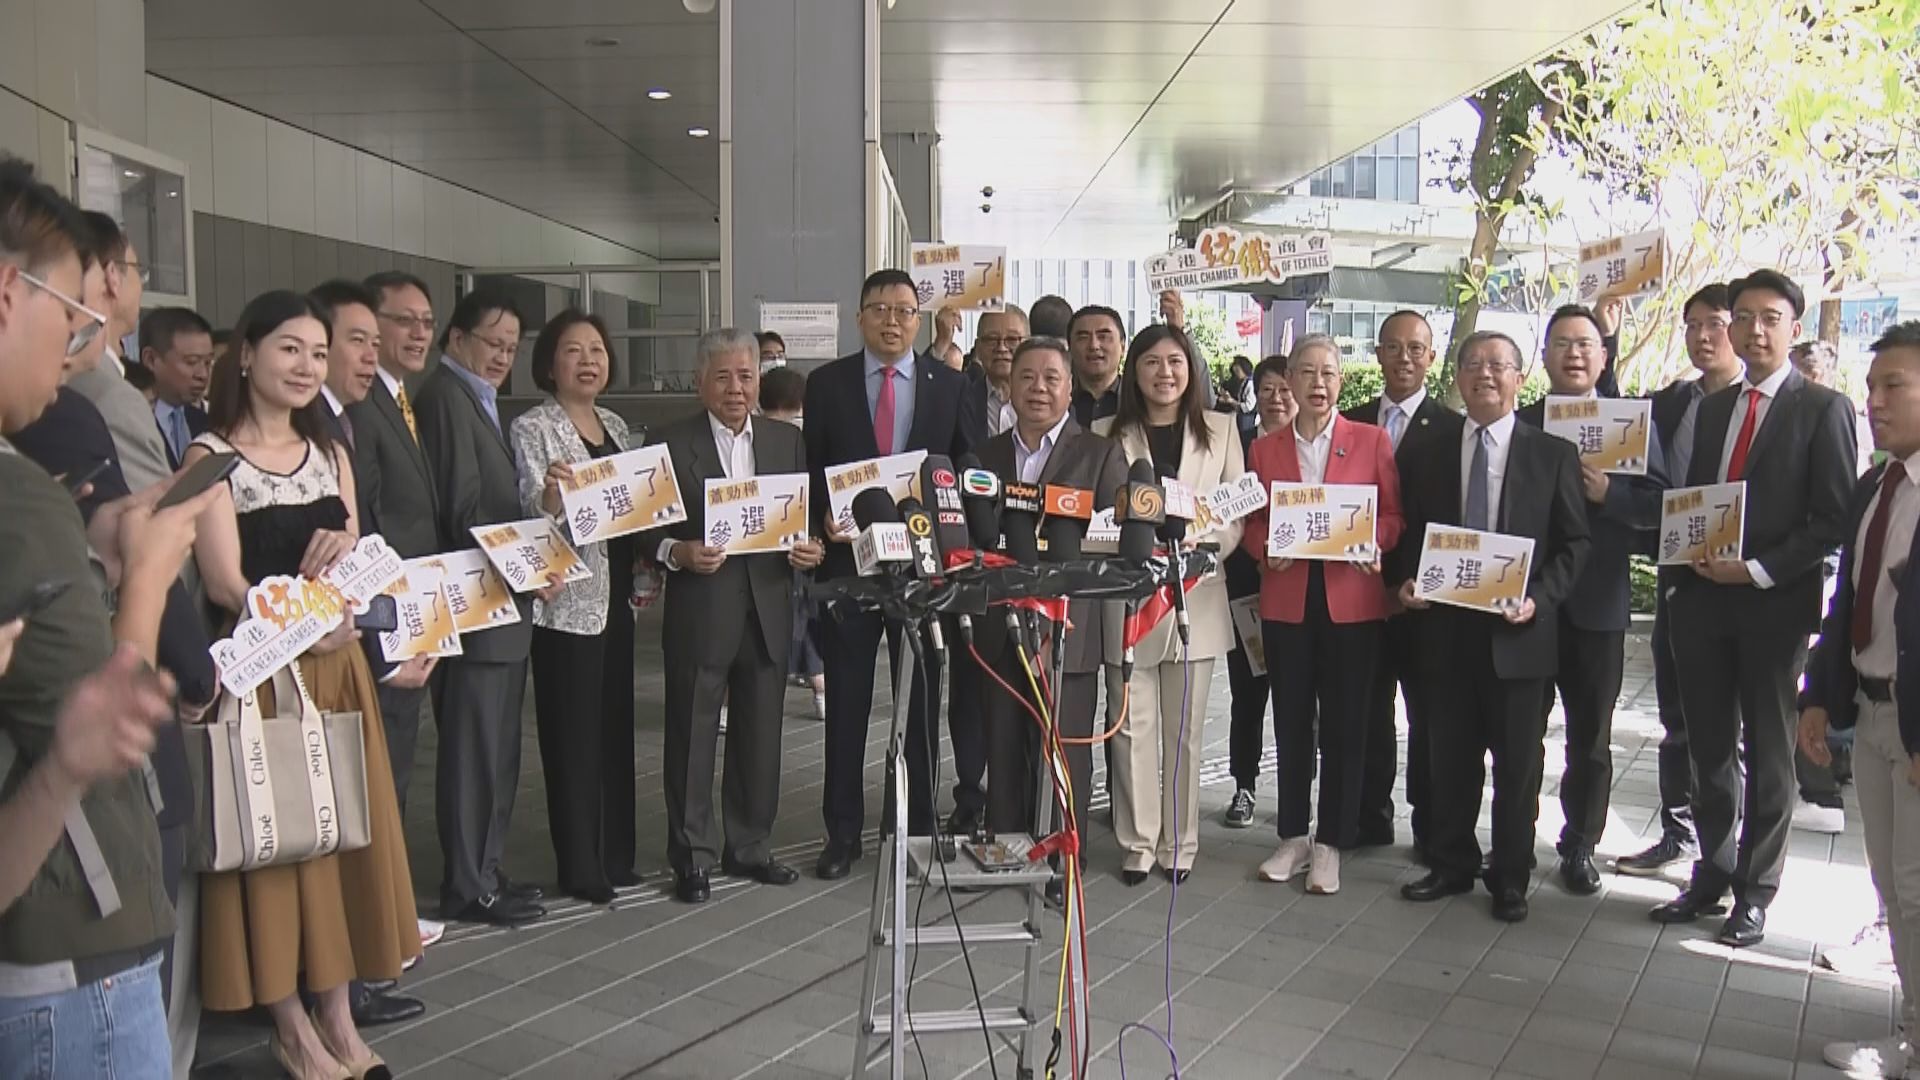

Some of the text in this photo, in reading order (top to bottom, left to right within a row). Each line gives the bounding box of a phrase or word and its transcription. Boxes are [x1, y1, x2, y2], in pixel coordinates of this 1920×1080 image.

[1151, 255, 1330, 290] HK GENERAL CHAMBER OF TEXTILES
[1006, 484, 1038, 498] now
[1232, 491, 1264, 513] TEXTILES
[279, 616, 322, 652] CHAMBER
